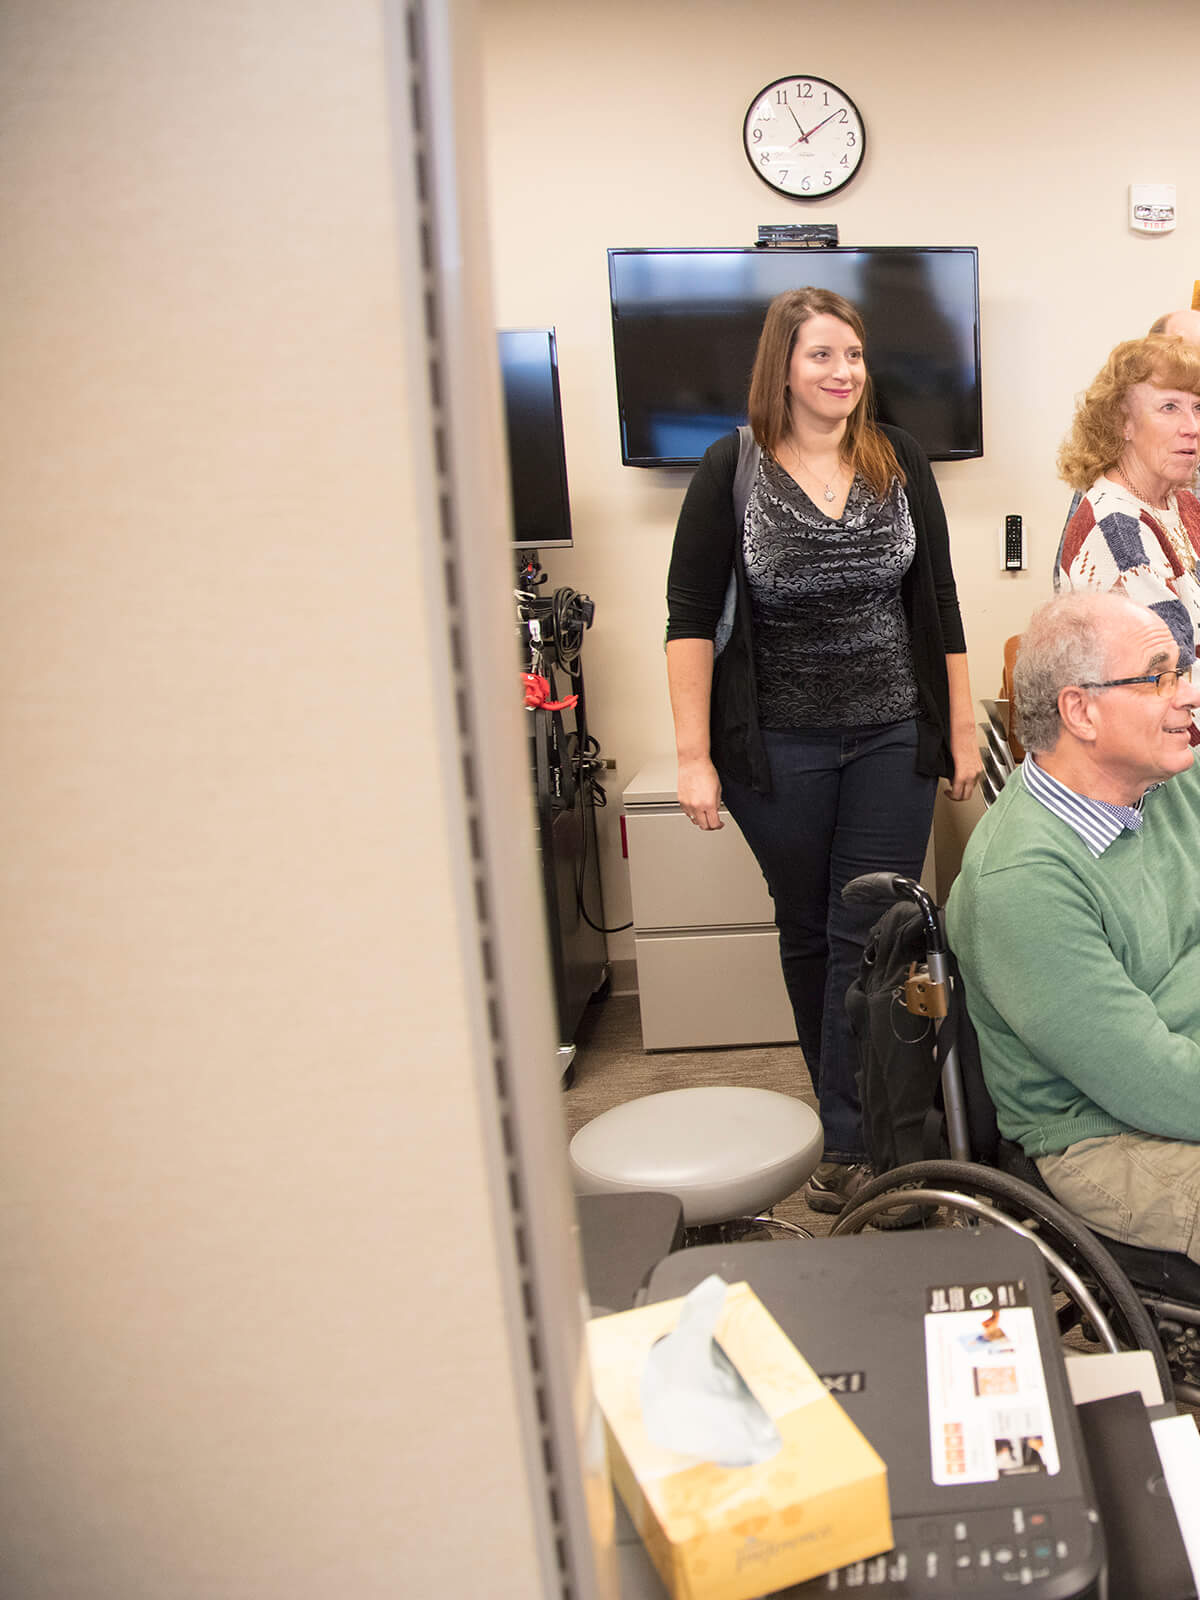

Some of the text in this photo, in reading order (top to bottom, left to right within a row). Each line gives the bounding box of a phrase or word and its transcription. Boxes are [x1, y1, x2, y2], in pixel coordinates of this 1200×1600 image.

[776, 90, 788, 105] 11
[796, 83, 813, 98] 12
[823, 92, 829, 106] 1
[839, 108, 849, 124] 2
[752, 128, 763, 144] 9
[846, 132, 856, 147] 3
[760, 152, 770, 166] 8
[839, 154, 849, 168] 4
[778, 170, 789, 185] 7
[801, 176, 811, 191] 6
[822, 171, 833, 186] 5
